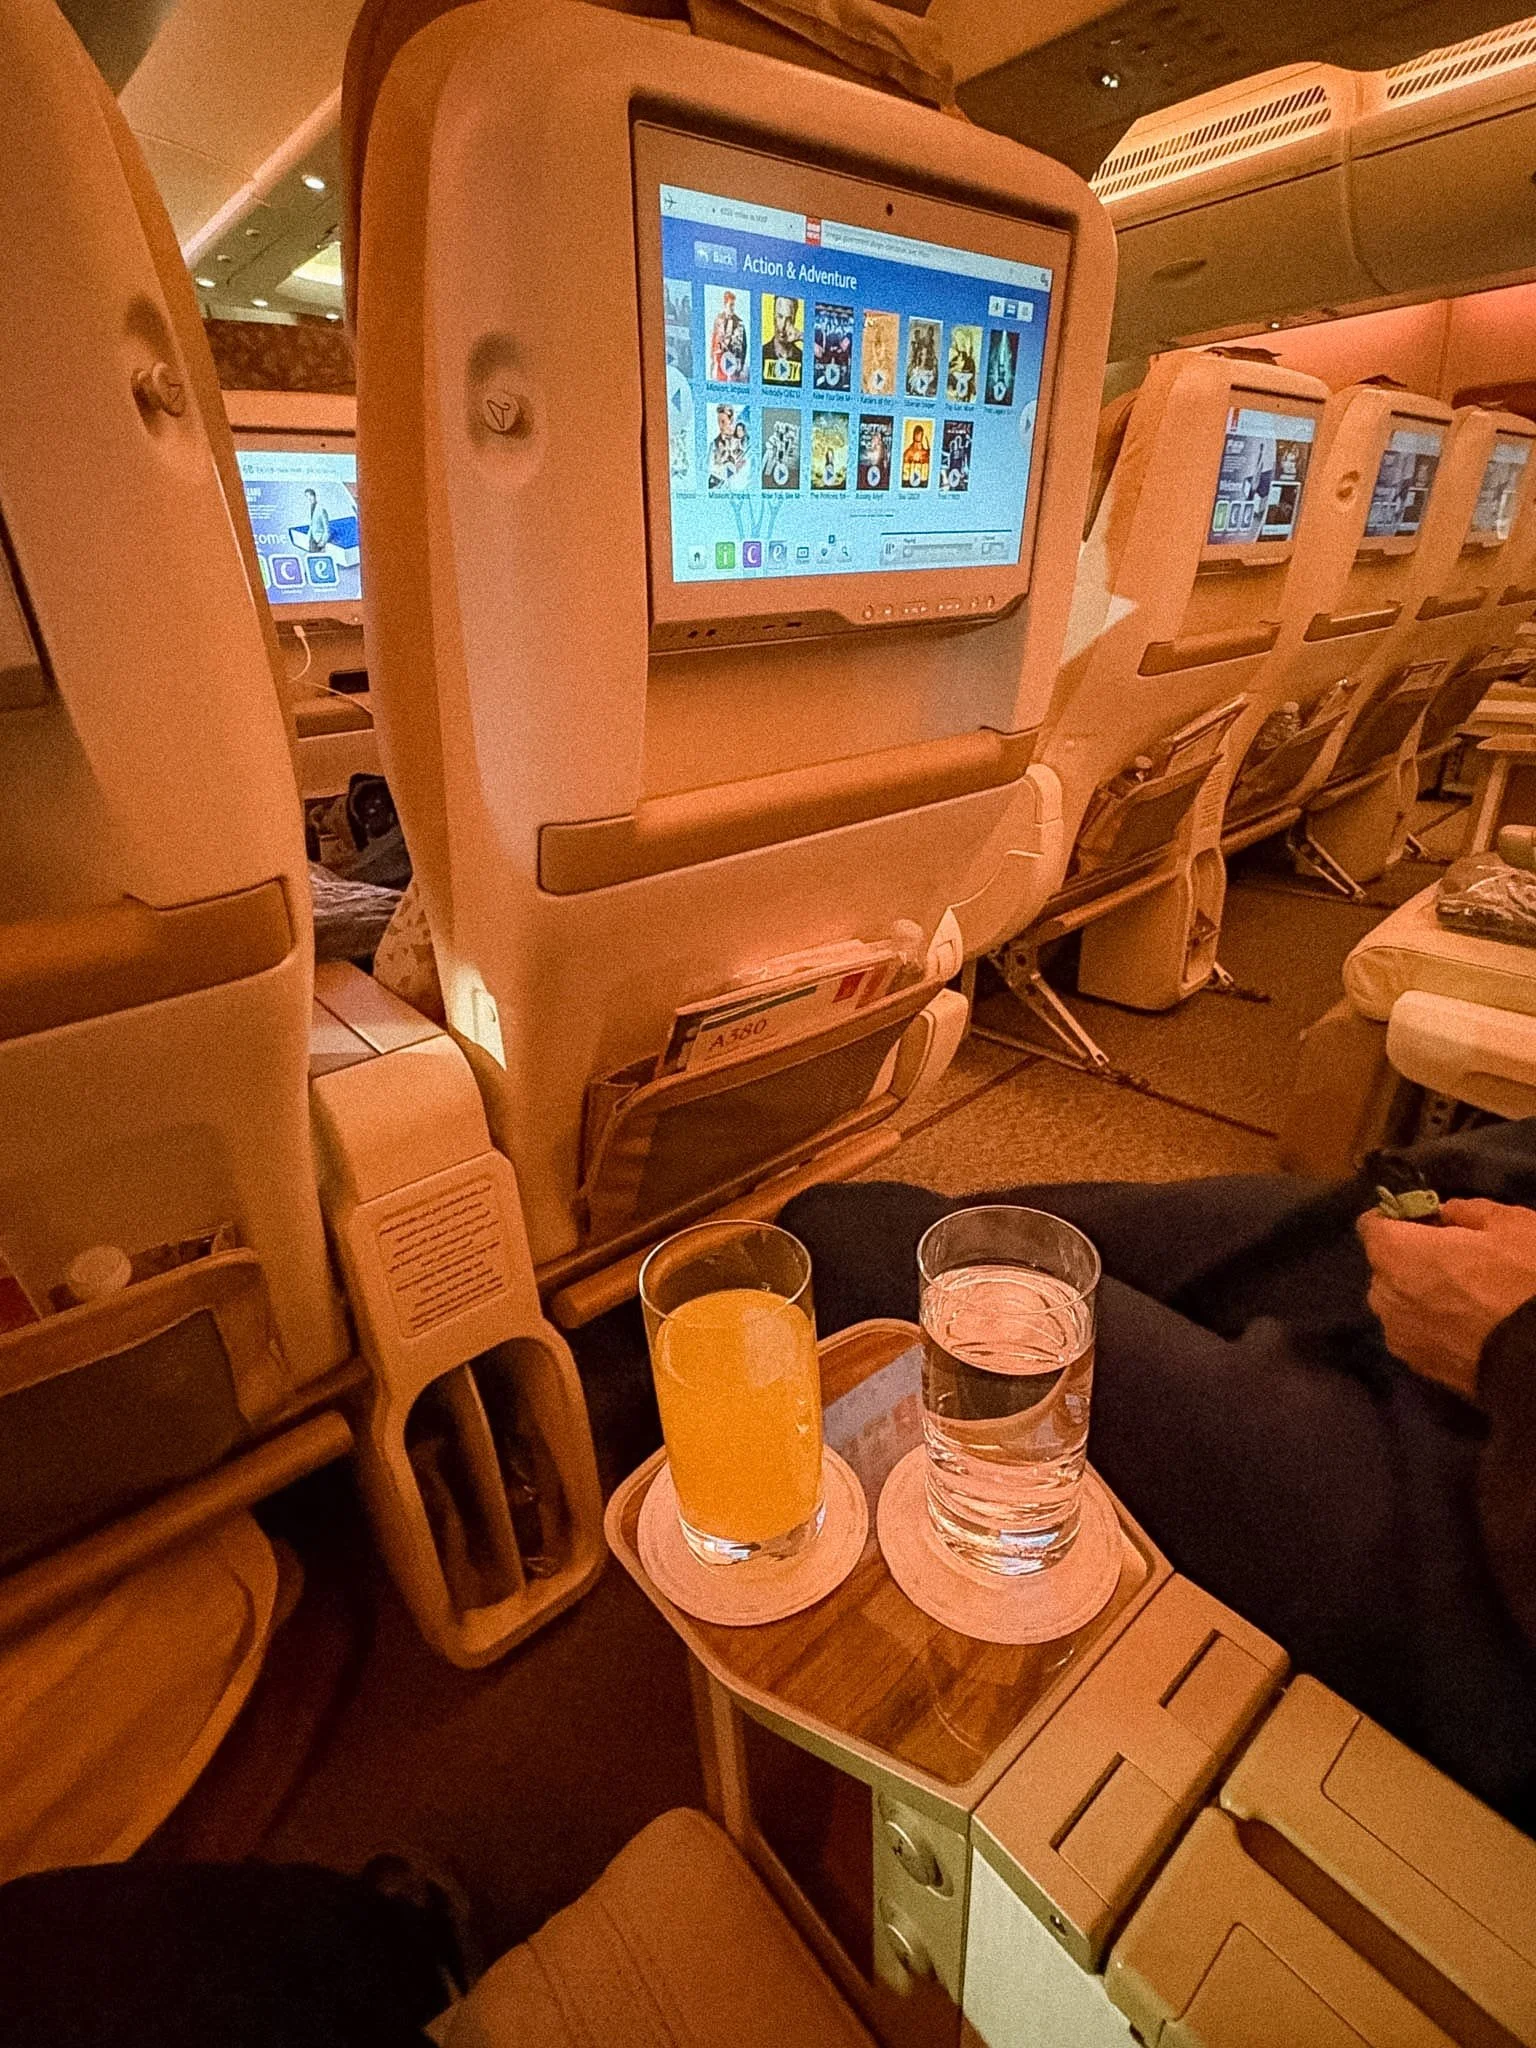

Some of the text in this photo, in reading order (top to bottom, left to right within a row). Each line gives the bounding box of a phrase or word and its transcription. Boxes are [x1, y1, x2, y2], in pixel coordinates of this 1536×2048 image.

[713, 251, 733, 266] Back
[743, 253, 857, 290] Action & Adventure
[708, 1019, 767, 1051] A380
